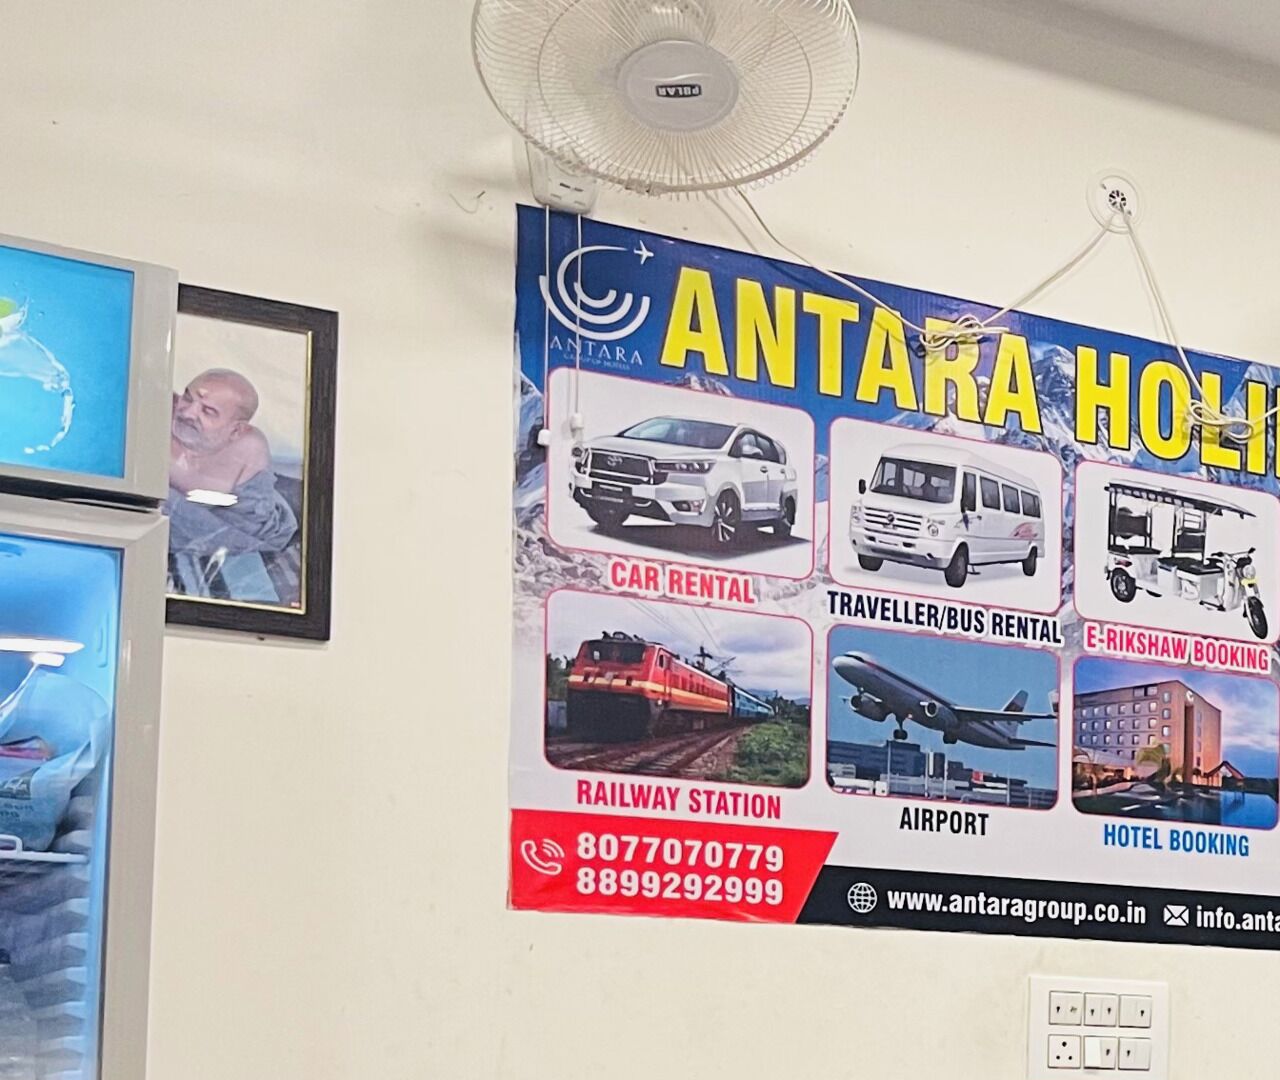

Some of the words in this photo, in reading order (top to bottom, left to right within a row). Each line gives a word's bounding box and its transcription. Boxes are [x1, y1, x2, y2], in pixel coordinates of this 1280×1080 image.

[549, 335, 643, 366] ANTARA
[660, 266, 1042, 433] ANTARA
[610, 561, 659, 590] CAR
[668, 567, 754, 603] RENTAL
[827, 590, 985, 634] TRAVELLER/BUS
[992, 613, 1062, 644] RENTAL
[1087, 625, 1188, 660] E-RIKSHAW
[1193, 642, 1269, 670] BOOKING
[577, 780, 680, 812] RAILWAY
[688, 789, 781, 819] STATION
[899, 807, 989, 836] AIRPORT
[1103, 823, 1163, 850] HOTEL
[1169, 829, 1249, 857] BOOKING
[576, 833, 784, 872] 8077070779
[576, 868, 784, 906] 8899292999
[887, 889, 1146, 927] www.antaragroup.co.in
